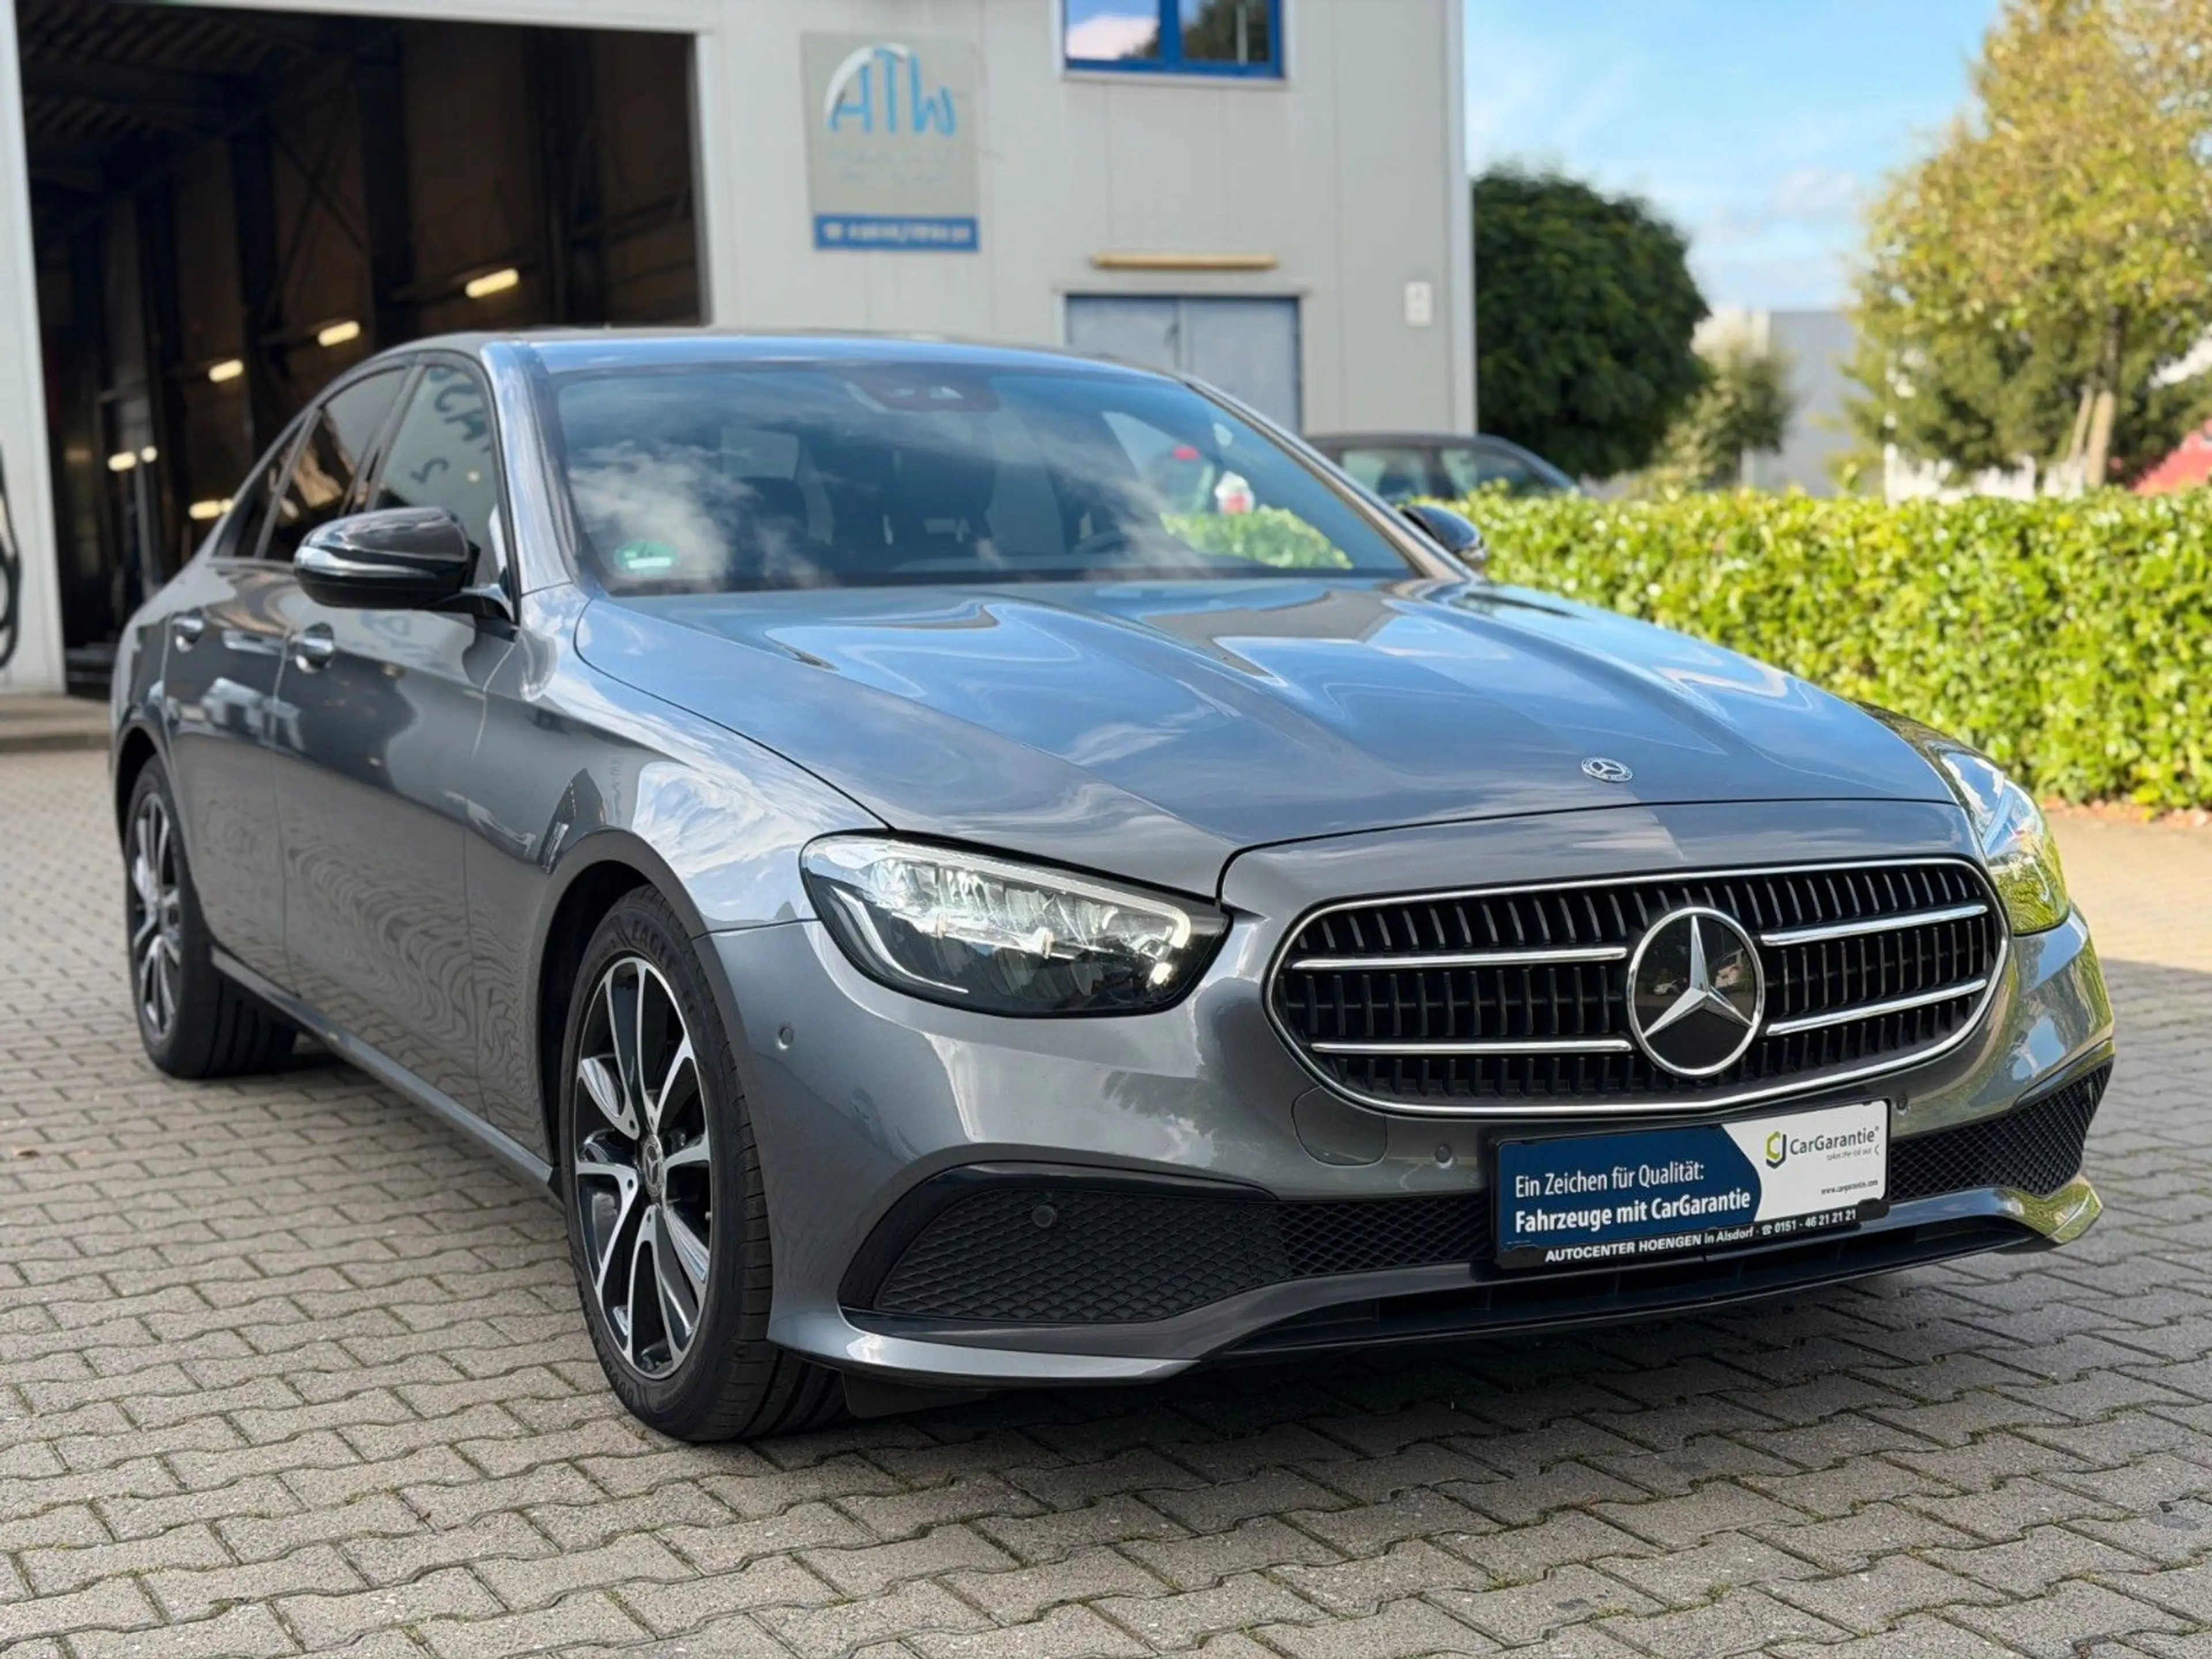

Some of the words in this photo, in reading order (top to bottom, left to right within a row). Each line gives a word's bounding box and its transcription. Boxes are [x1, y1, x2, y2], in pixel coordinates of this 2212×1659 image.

[827, 46, 957, 135] ATW
[1515, 1175, 1540, 1198] Ein
[1544, 1169, 1607, 1195] Zeichen
[1611, 1166, 1635, 1190] für
[1639, 1160, 1705, 1188] Qualität:
[1515, 1209, 1612, 1233] Fahrzeuge
[1616, 1199, 1647, 1224] mit
[1651, 1187, 1751, 1219] CarGarantie
[1544, 1241, 1636, 1263] AUTOCENTER
[1638, 1233, 1702, 1253] HOENGEN
[1716, 1225, 1754, 1243] Alsdorf
[1774, 1219, 1797, 1233] 0151
[1805, 1216, 1817, 1228] 46
[1819, 1213, 1830, 1226] 21
[1832, 1211, 1843, 1223] 21
[1845, 1209, 1856, 1221] 21
